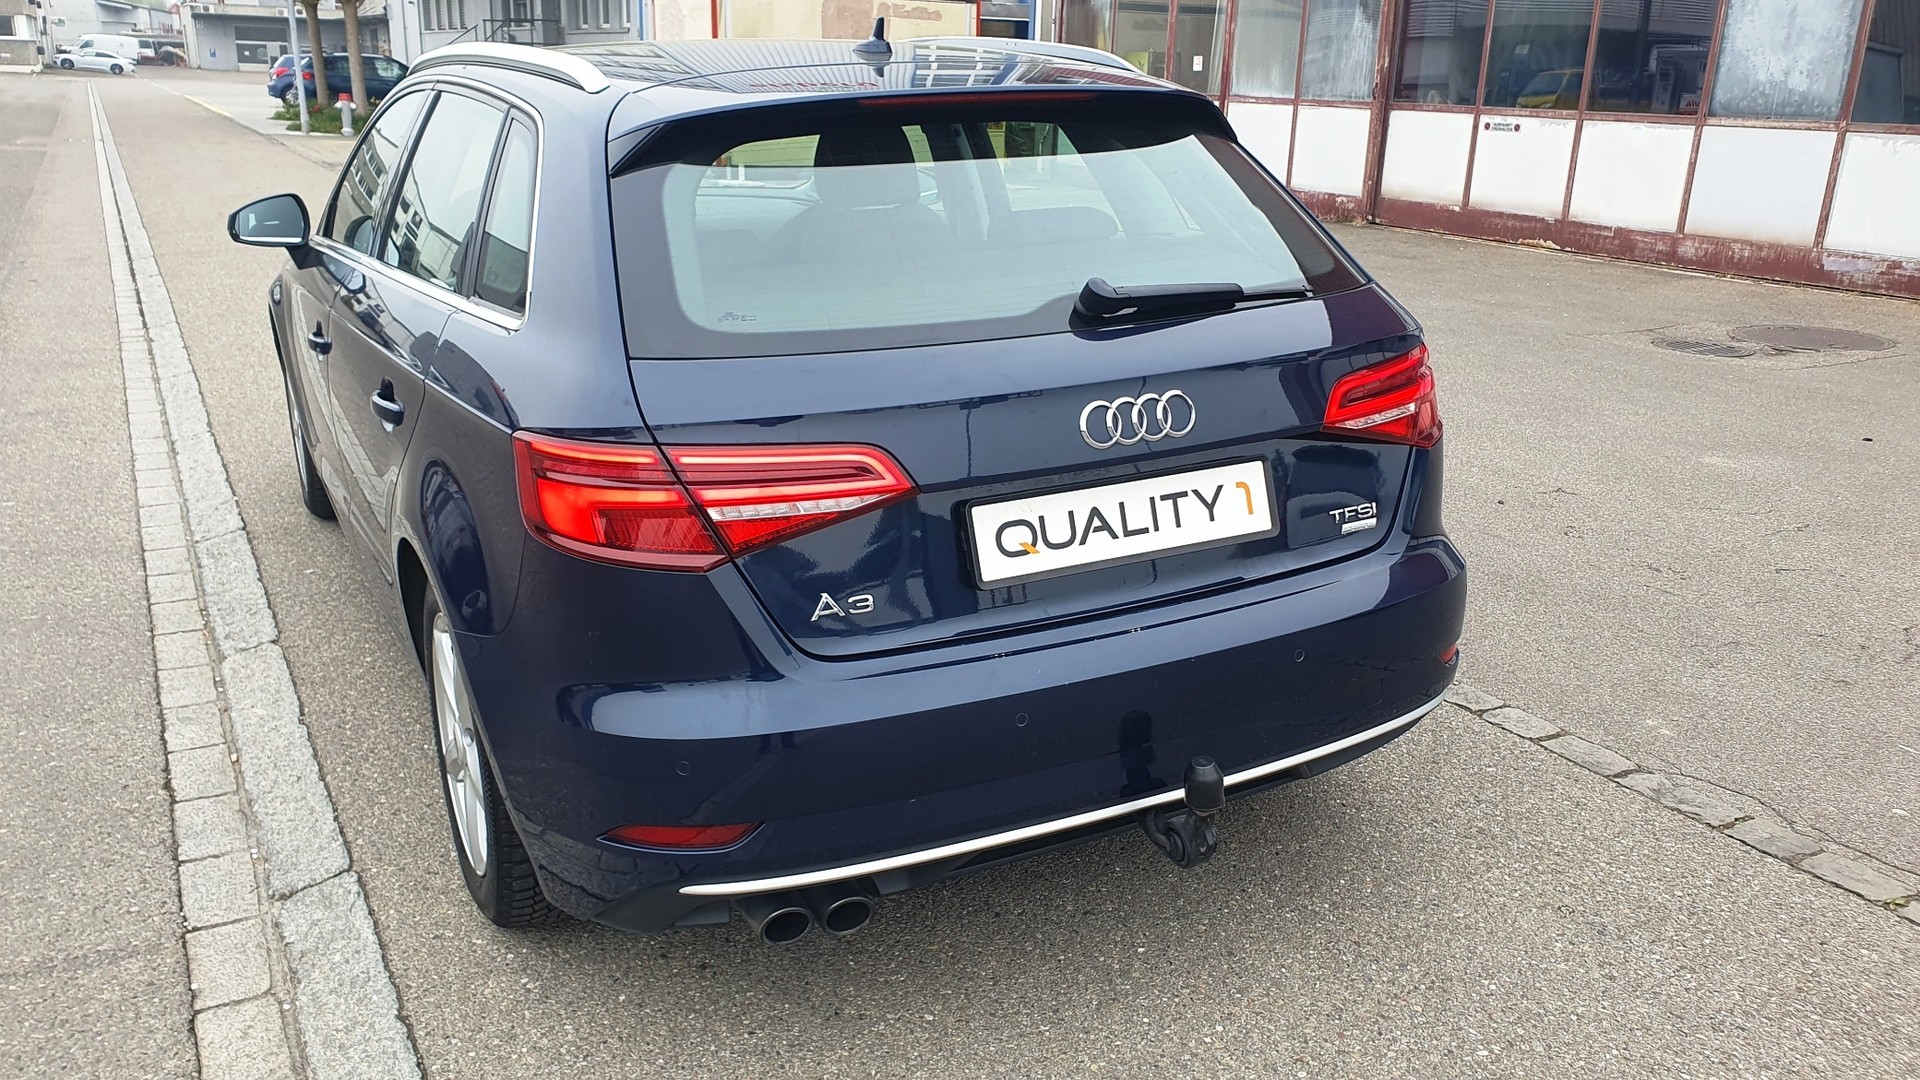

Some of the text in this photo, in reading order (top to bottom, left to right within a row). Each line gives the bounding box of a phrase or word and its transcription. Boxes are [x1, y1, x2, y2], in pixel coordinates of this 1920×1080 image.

[995, 484, 1224, 558] QUALITY
[1328, 501, 1377, 524] TFSI
[810, 592, 875, 622] A3
